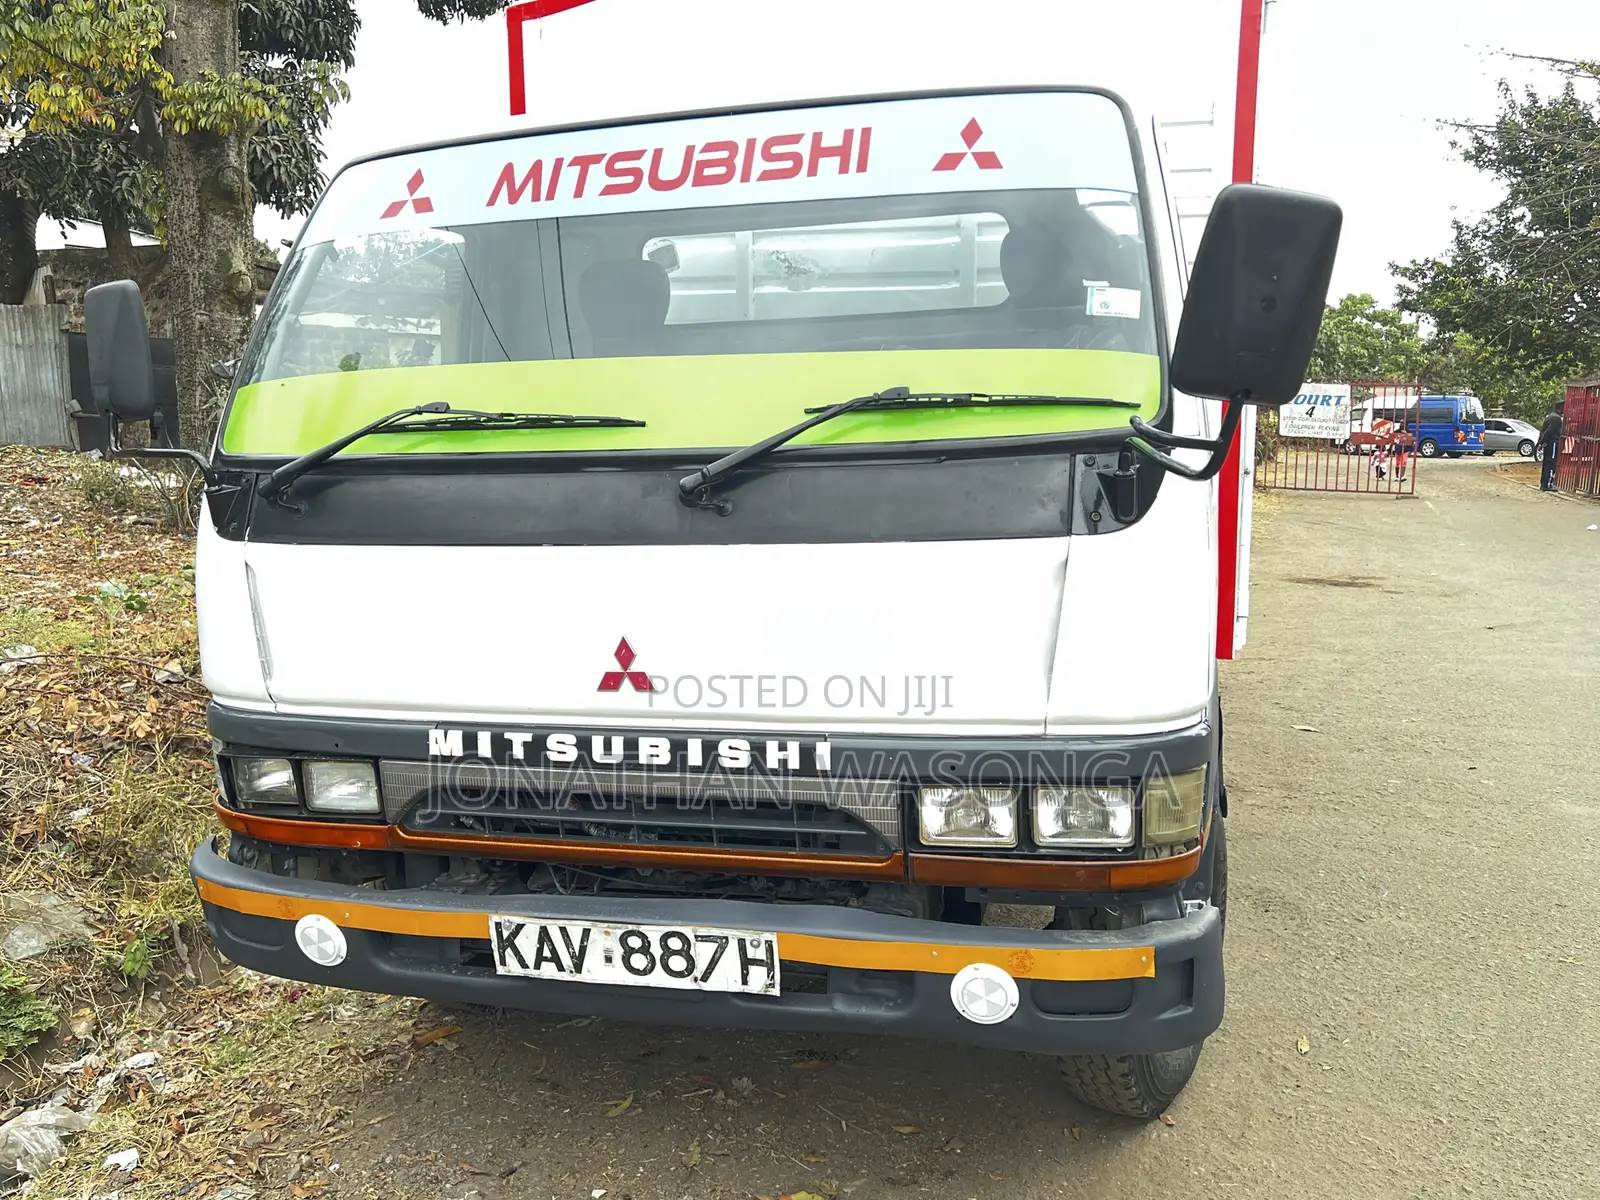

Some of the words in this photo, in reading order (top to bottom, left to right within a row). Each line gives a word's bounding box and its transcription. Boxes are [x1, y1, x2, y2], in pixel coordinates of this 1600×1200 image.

[486, 127, 872, 207] MITSUBISHI
[1293, 394, 1346, 406] OURT
[1305, 406, 1316, 418] 4
[428, 728, 831, 771] MITSUBISHI
[494, 922, 591, 974] KAV
[618, 929, 776, 988] 887H
